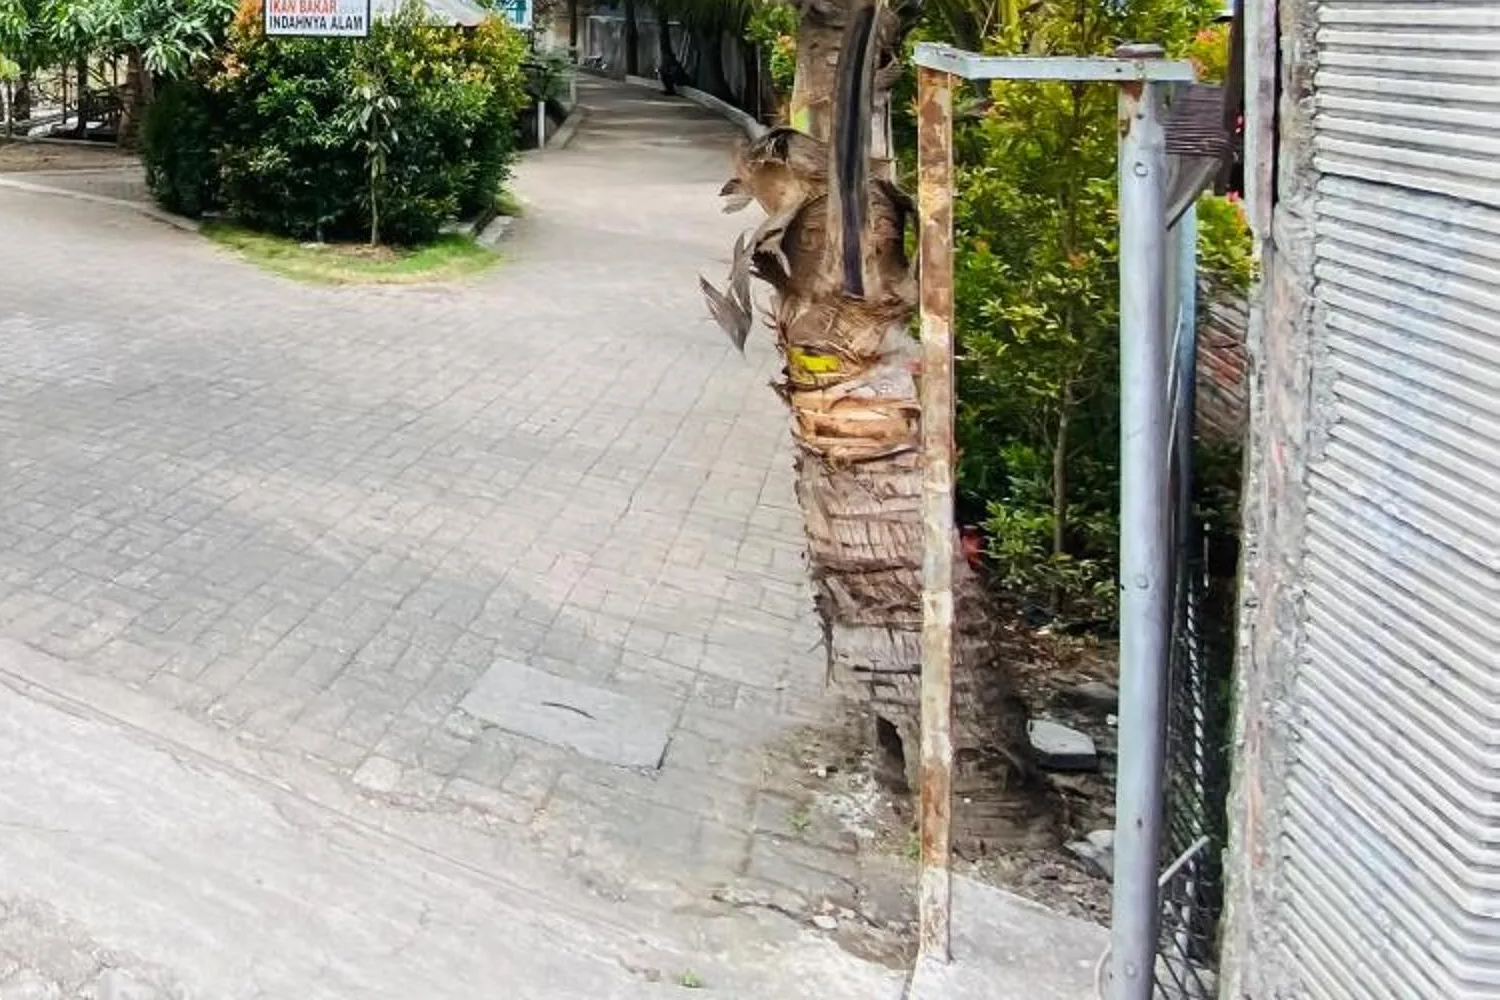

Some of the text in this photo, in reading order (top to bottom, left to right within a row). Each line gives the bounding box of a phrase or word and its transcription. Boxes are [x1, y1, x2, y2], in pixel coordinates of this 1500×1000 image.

[269, 0, 297, 13] IKAN
[300, 0, 337, 13] BAKAR
[269, 15, 363, 30] INDAHNYA ALAM
